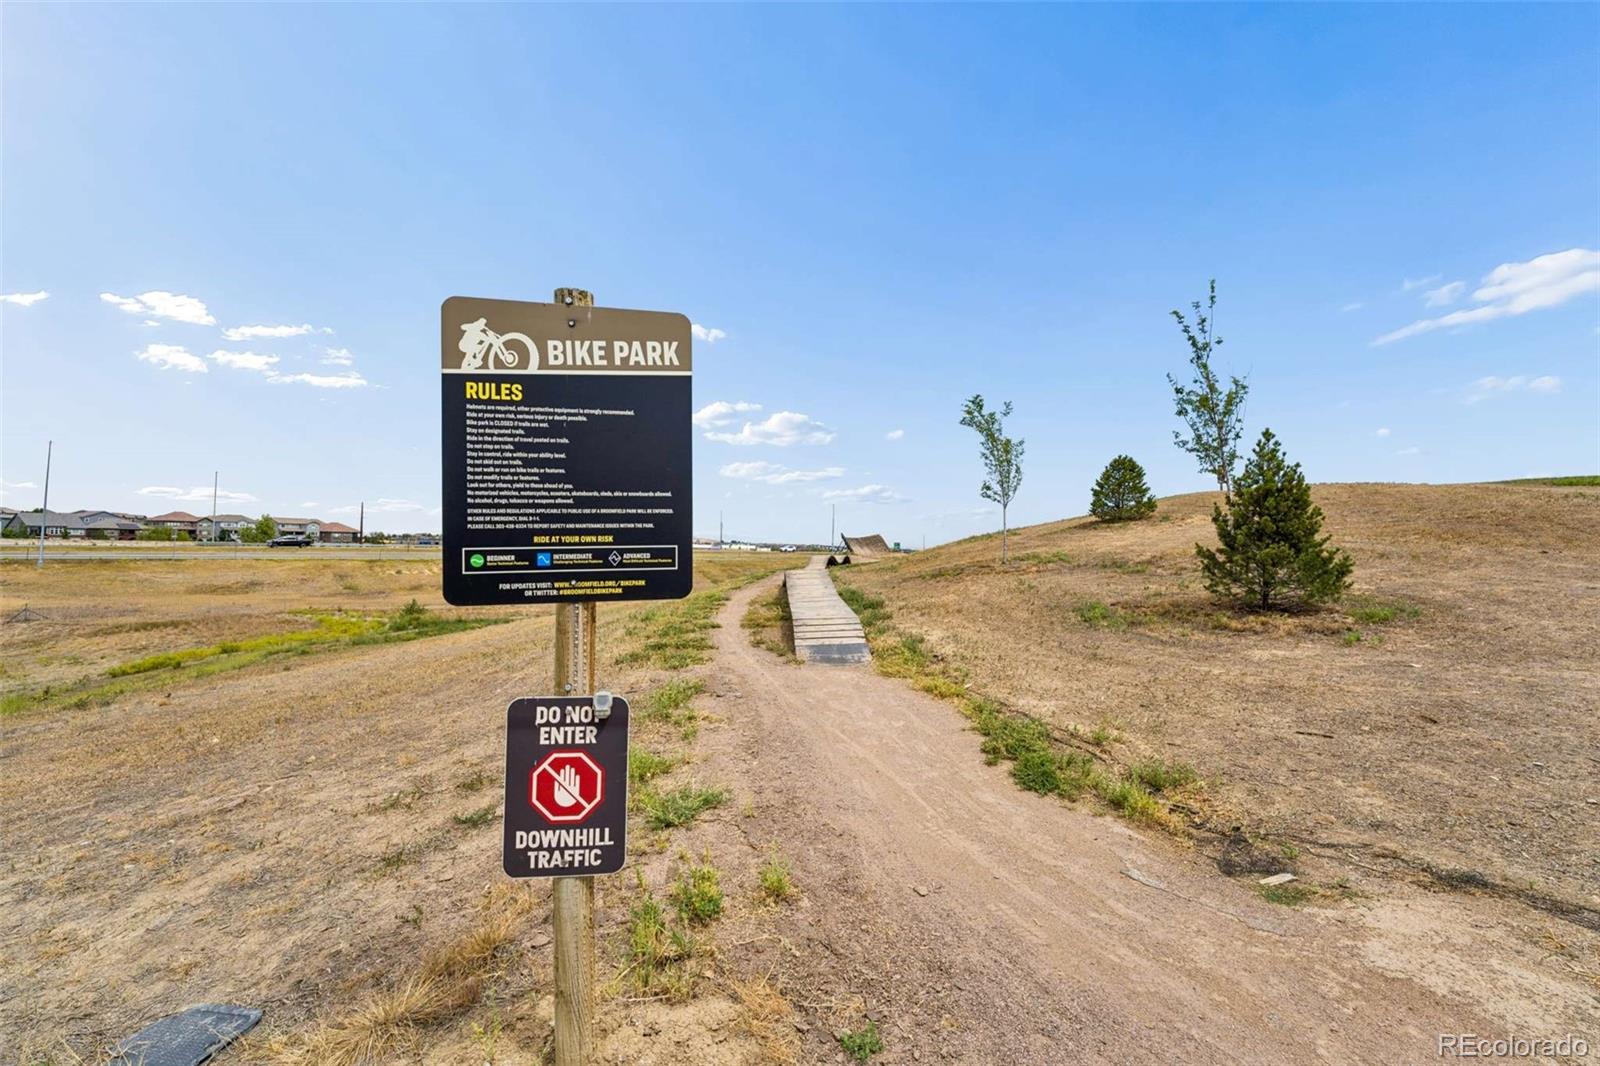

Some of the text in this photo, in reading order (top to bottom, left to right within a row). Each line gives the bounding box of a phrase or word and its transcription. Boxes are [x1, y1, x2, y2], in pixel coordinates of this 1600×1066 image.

[546, 340, 680, 366] BIKE PARK
[465, 382, 523, 401] RULES
[536, 706, 599, 725] DO NO
[539, 726, 598, 745] ENTER
[515, 828, 614, 848] DOWNHILL
[528, 848, 602, 868] TRAFFIC
